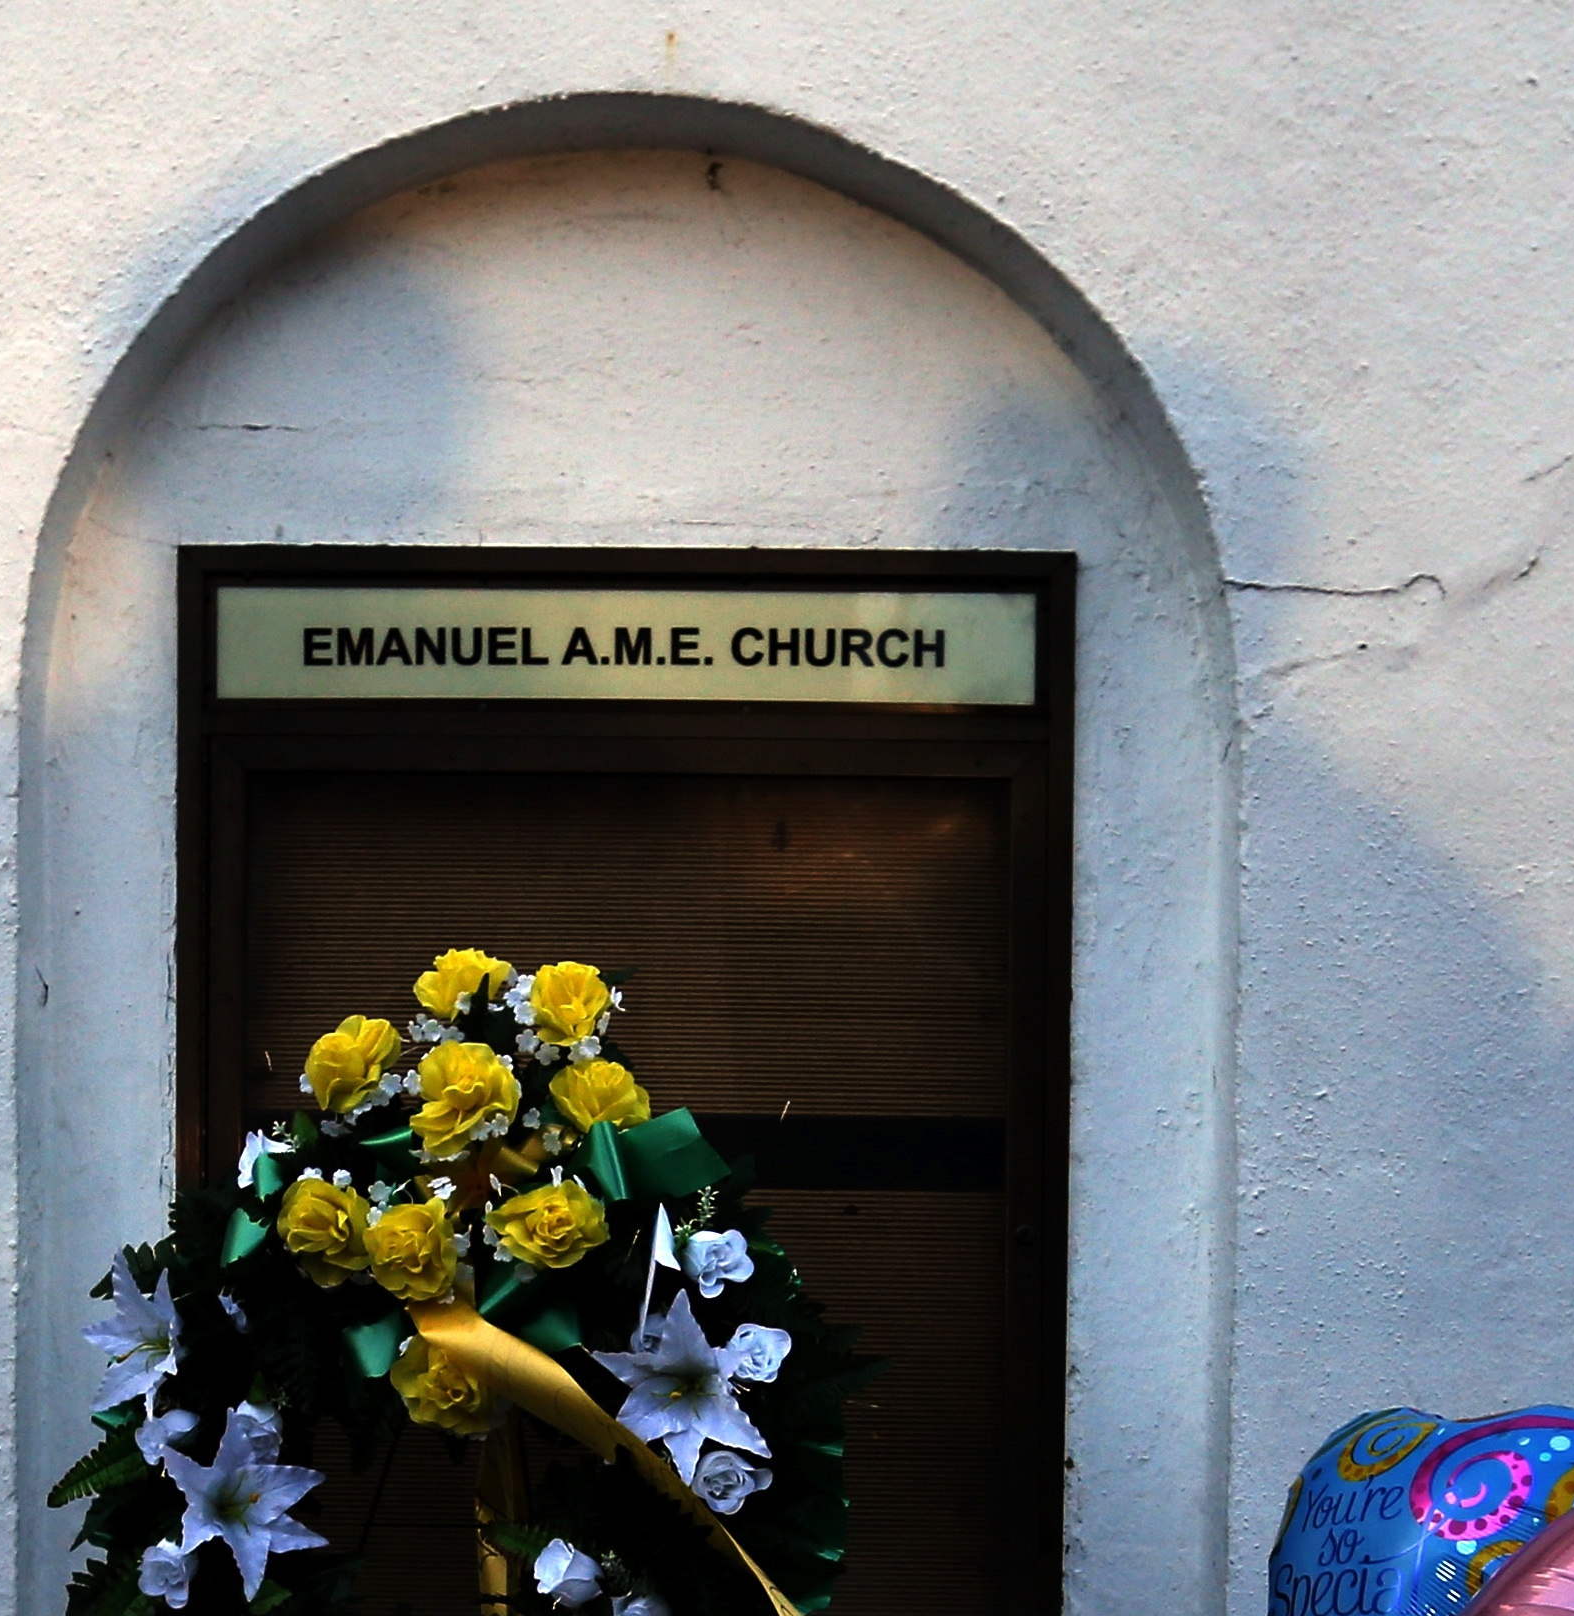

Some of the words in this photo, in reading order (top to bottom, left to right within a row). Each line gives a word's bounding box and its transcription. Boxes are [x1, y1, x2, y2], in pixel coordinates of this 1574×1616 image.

[303, 627, 549, 666] EMANUEL
[561, 627, 714, 666] A.M.E.
[731, 627, 945, 668] CHURCH
[1302, 1475, 1405, 1534] You're
[1318, 1527, 1366, 1567] so
